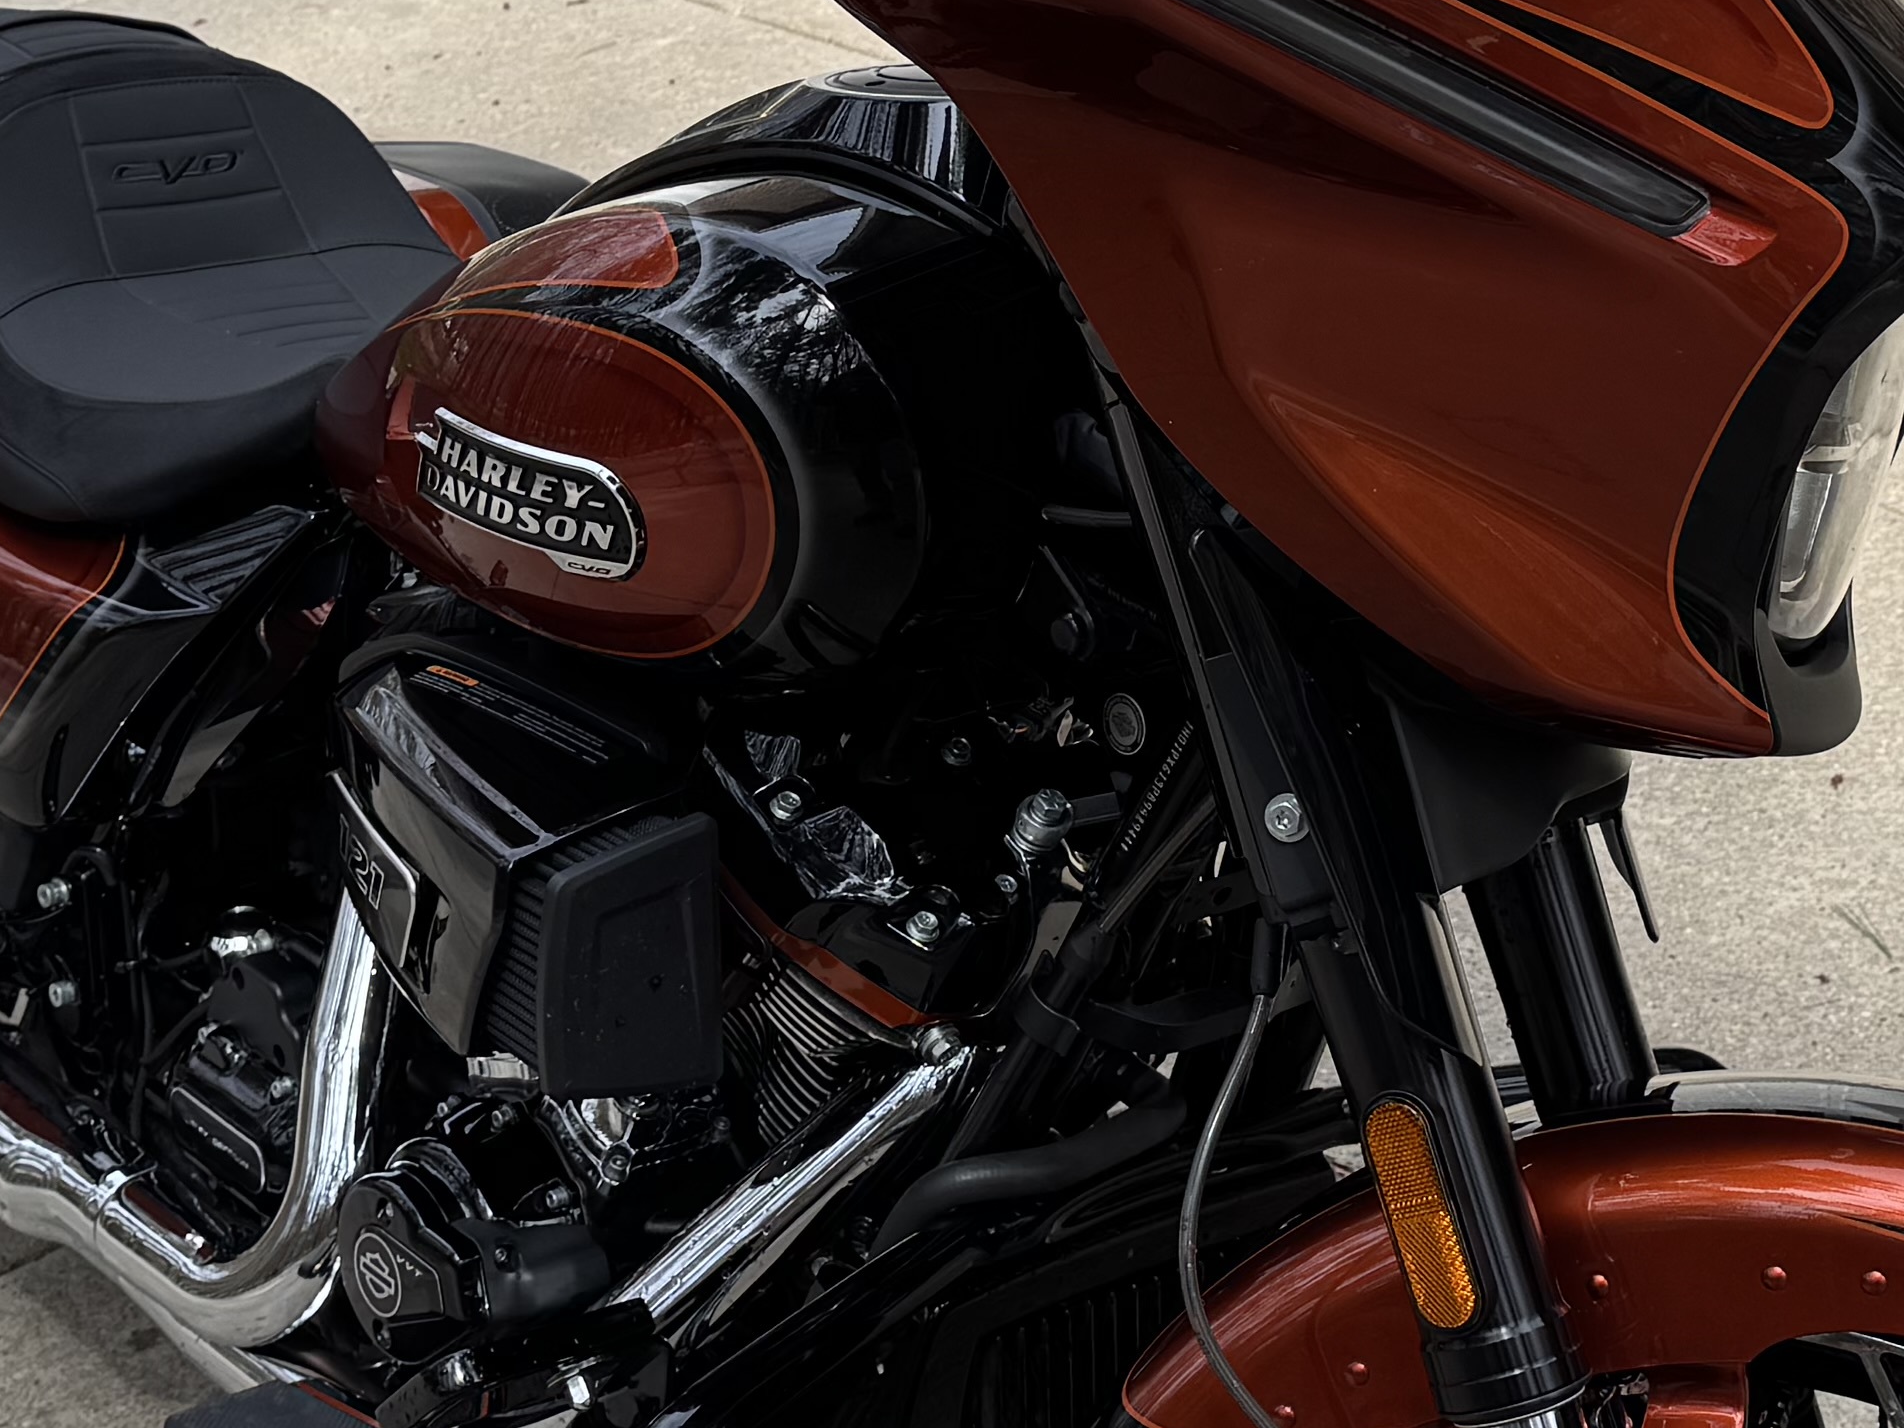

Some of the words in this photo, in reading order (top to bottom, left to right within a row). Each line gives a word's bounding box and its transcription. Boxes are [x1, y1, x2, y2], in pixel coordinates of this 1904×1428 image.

[112, 152, 239, 185] CVO
[425, 465, 615, 551] DAVIDSON
[441, 436, 608, 509] HARLEY-
[339, 813, 384, 910] 121
